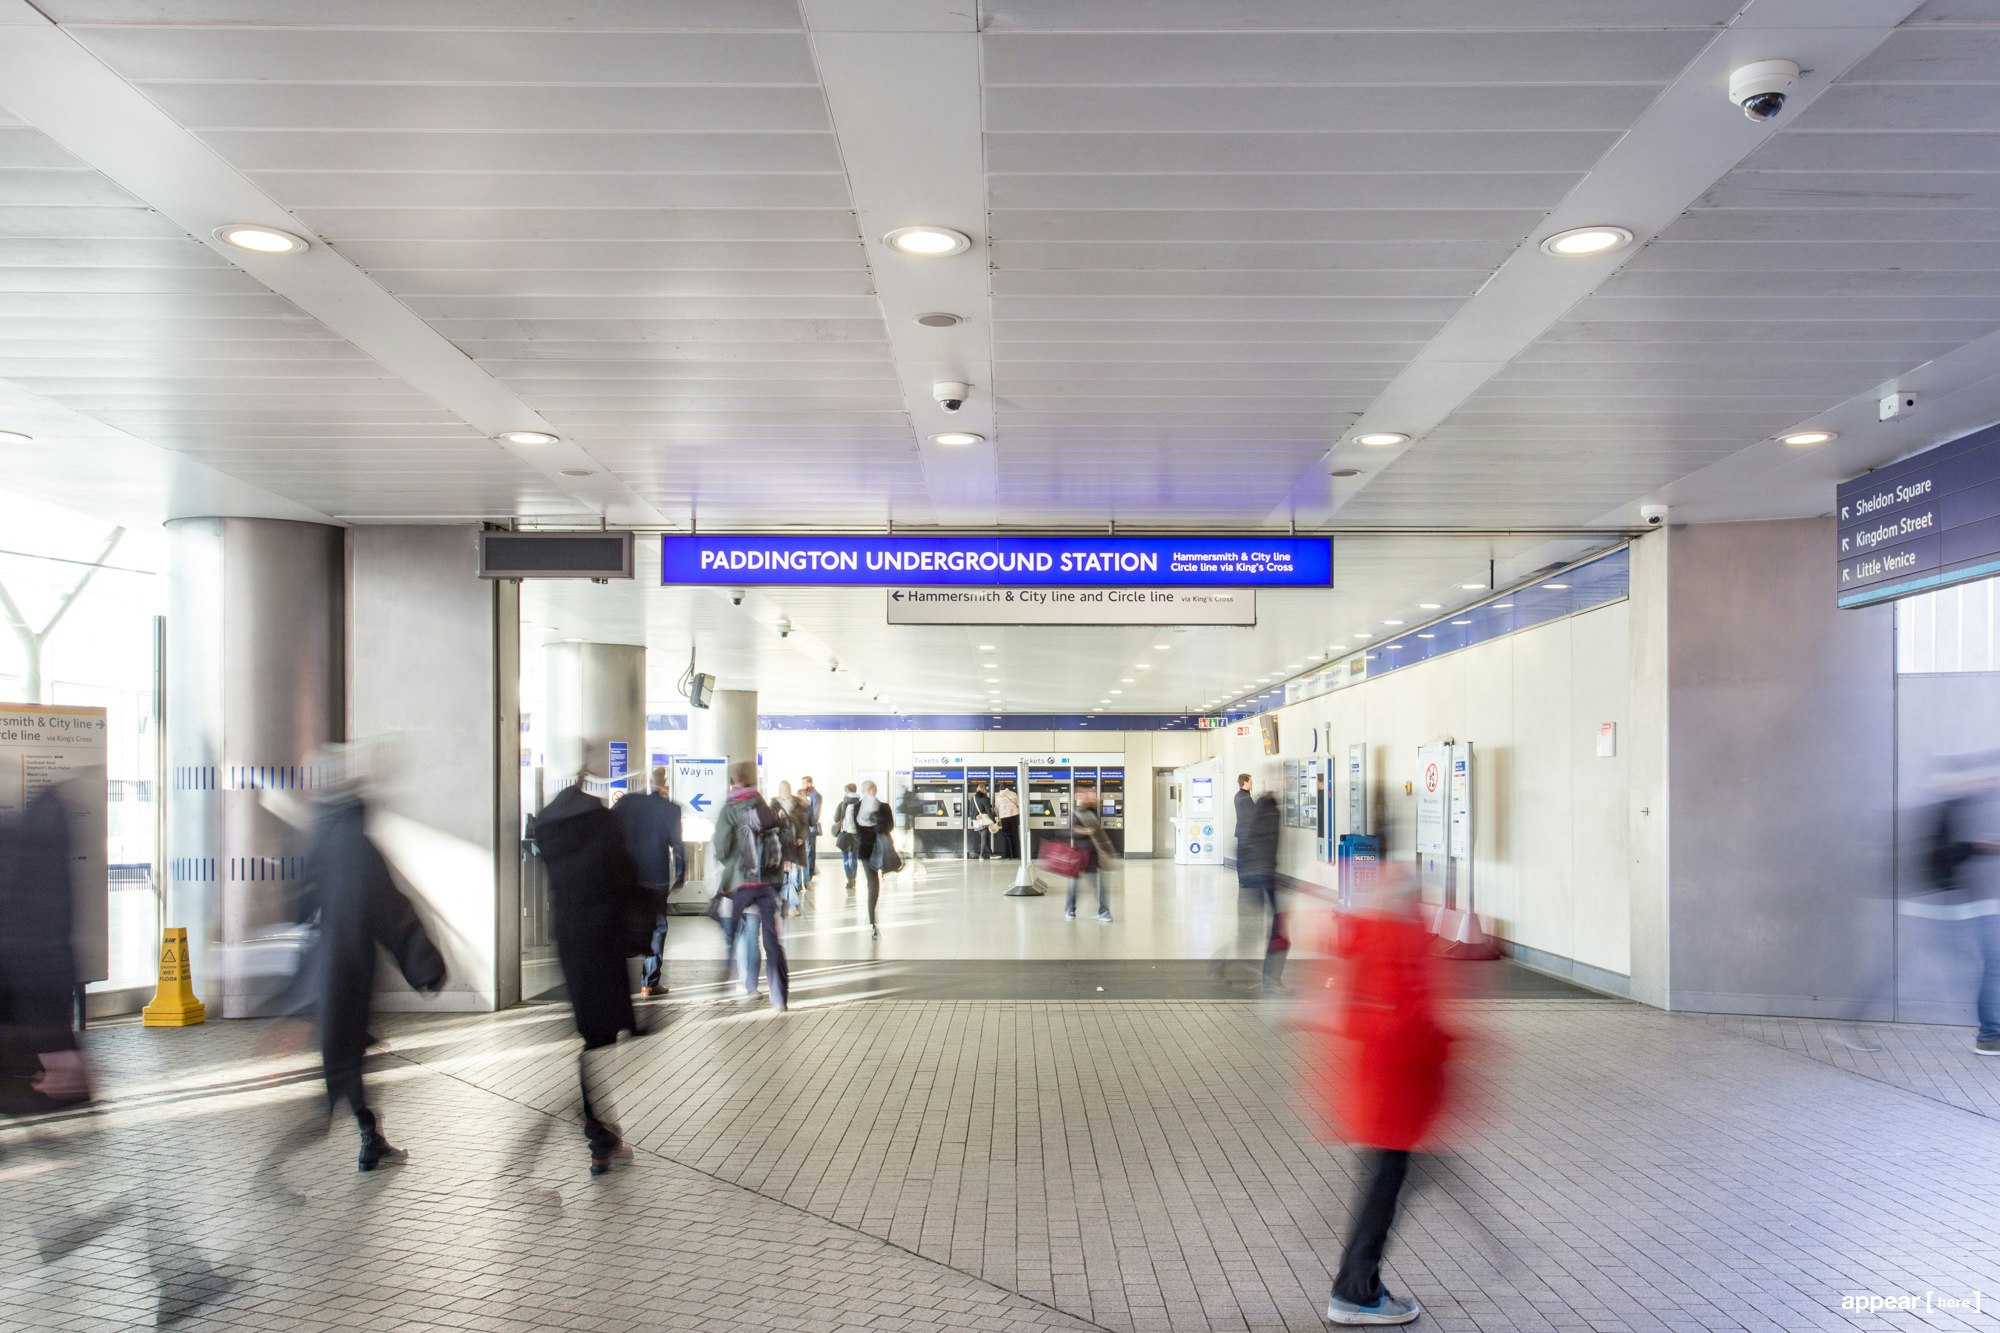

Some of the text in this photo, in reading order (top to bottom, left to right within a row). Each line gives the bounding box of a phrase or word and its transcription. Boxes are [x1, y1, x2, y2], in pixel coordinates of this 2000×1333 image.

[1856, 479, 1932, 516] Sheldon Square
[1856, 512, 1933, 548] Kingdom Street
[701, 550, 1158, 572] PADDINGTON UNDERGROUND STATION
[1173, 552, 1291, 564] Hammersmith & City line
[1856, 551, 1916, 579] Little Venice
[1170, 562, 1294, 574] Circle line via King's Cross
[908, 590, 1000, 602] Hammersmith
[1005, 591, 1015, 602] &
[1019, 590, 1047, 605] City
[1051, 590, 1075, 602] line
[1079, 590, 1103, 602] and
[1108, 590, 1146, 602] Circle
[1150, 590, 1174, 602] line
[1193, 596, 1213, 604] King's
[37, 717, 46, 728] &
[49, 717, 71, 731] City
[74, 718, 92, 729] line
[20, 730, 41, 741] line
[680, 767, 714, 778] Way in
